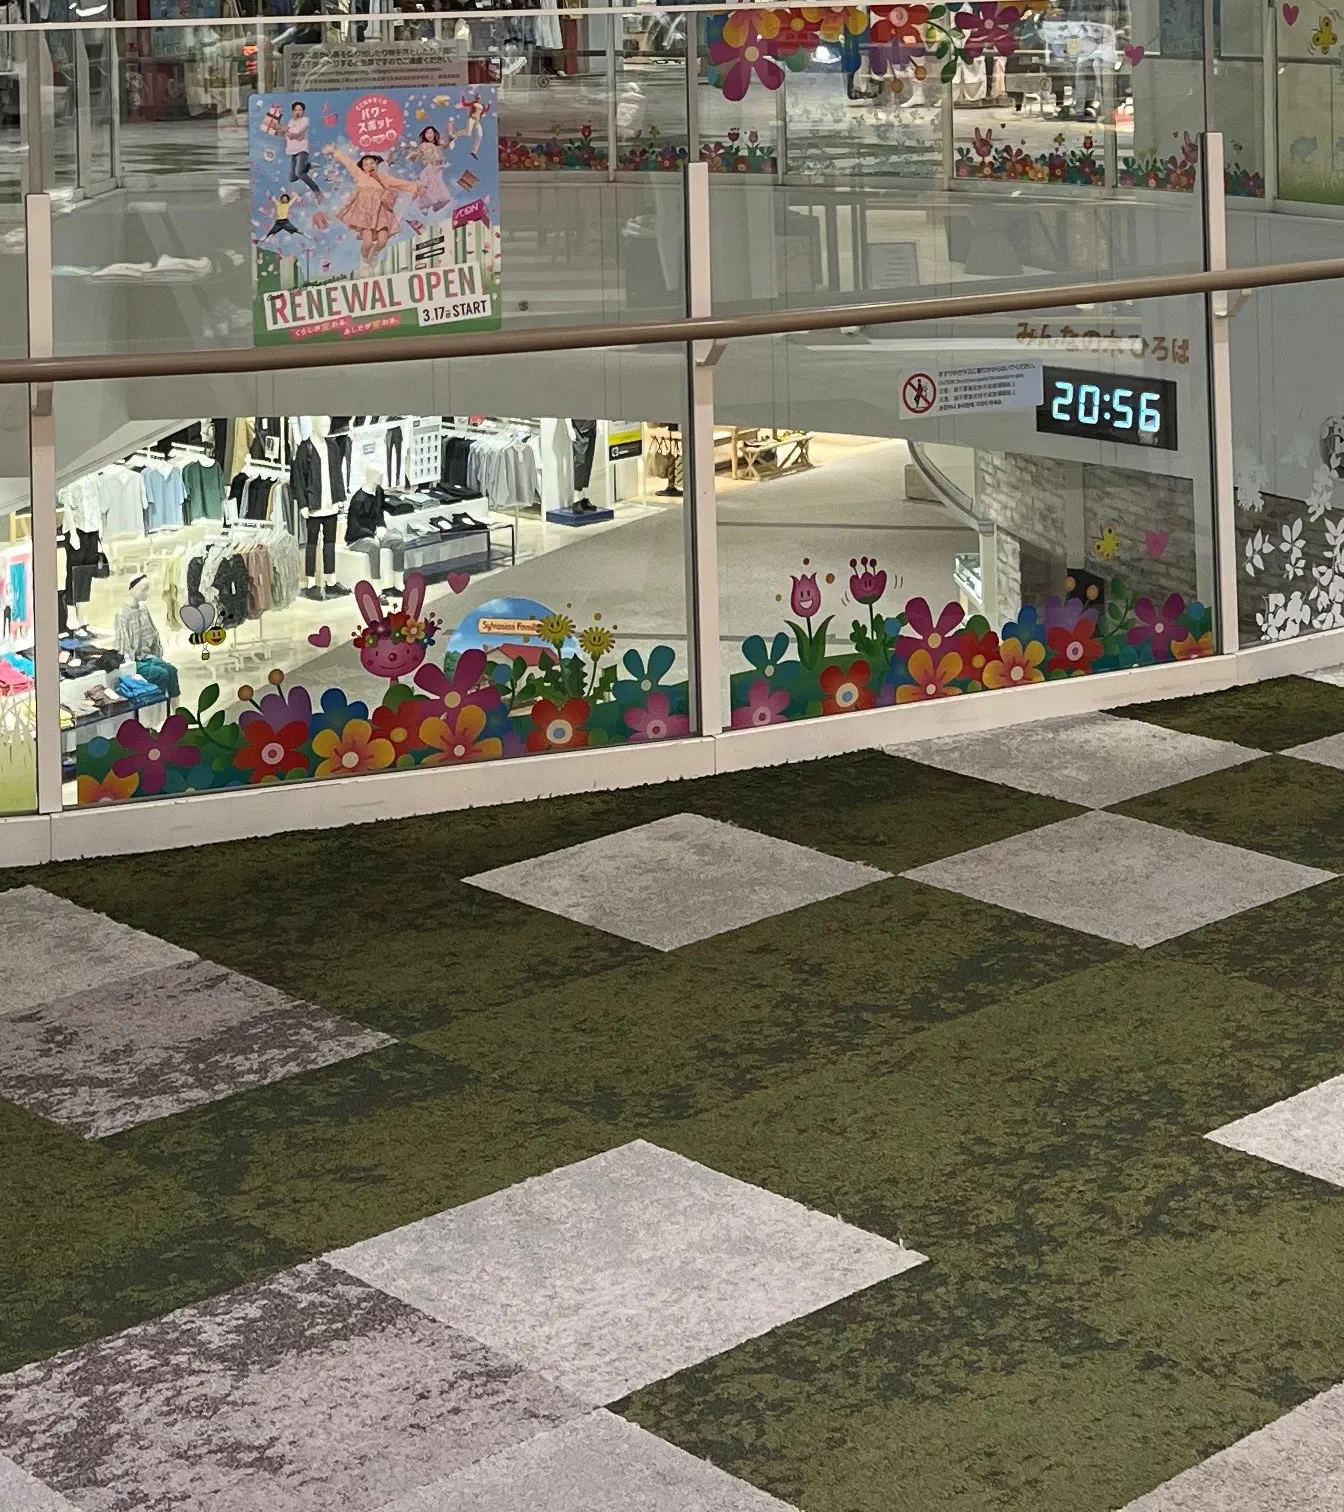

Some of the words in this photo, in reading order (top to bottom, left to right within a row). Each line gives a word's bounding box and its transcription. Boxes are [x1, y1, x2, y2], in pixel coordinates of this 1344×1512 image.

[362, 107, 387, 120] パワー
[358, 117, 394, 134] スポット
[270, 278, 403, 326] RENEWAL
[408, 266, 478, 304] OPEN
[452, 300, 488, 315] START
[1053, 381, 1161, 432] 20:56
